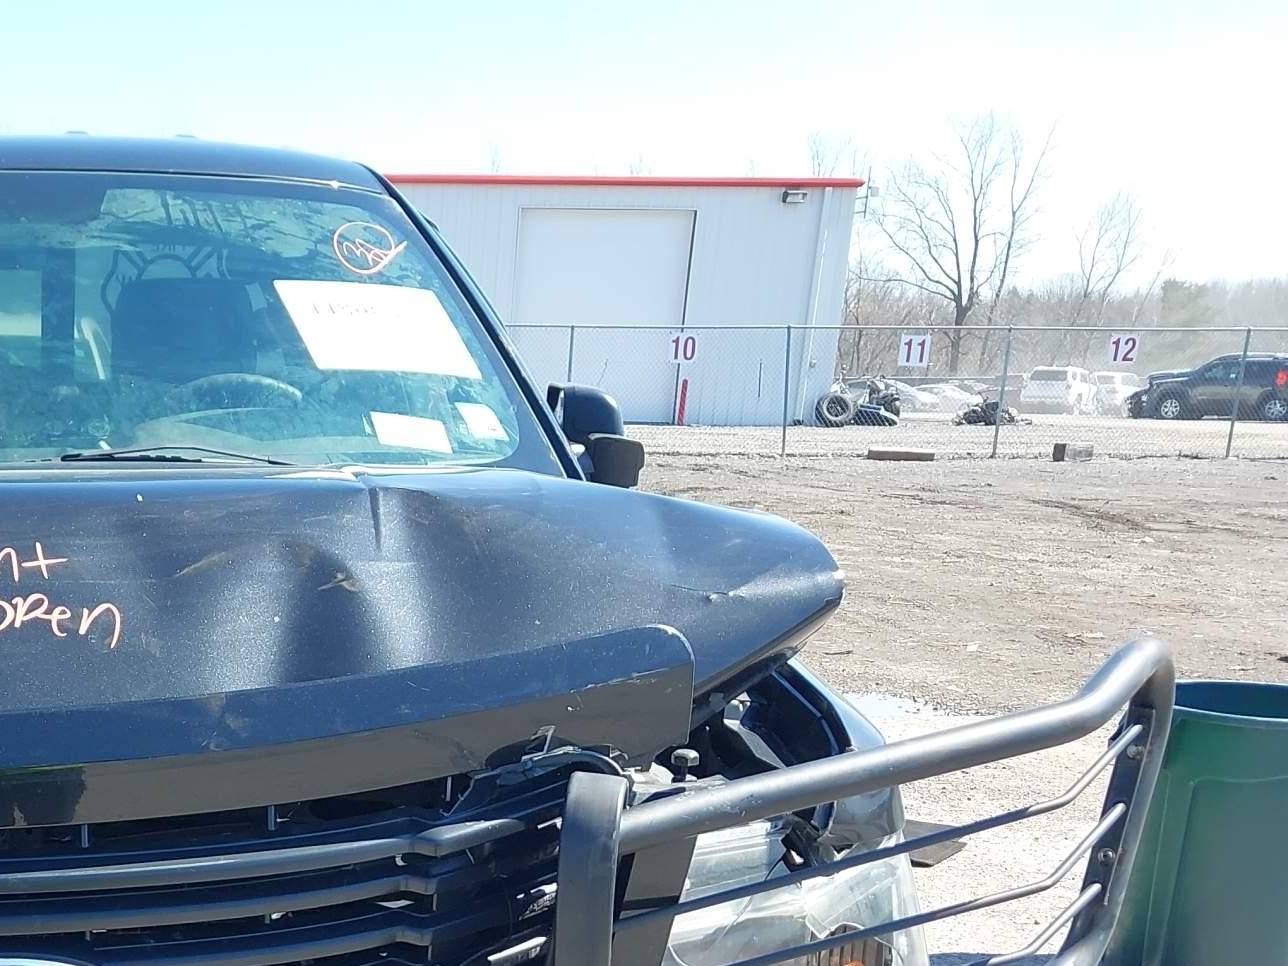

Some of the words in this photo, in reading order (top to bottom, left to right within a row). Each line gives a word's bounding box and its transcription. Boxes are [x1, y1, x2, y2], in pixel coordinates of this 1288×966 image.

[671, 336, 697, 361] 10
[902, 337, 927, 364] 11
[1111, 336, 1137, 362] 12
